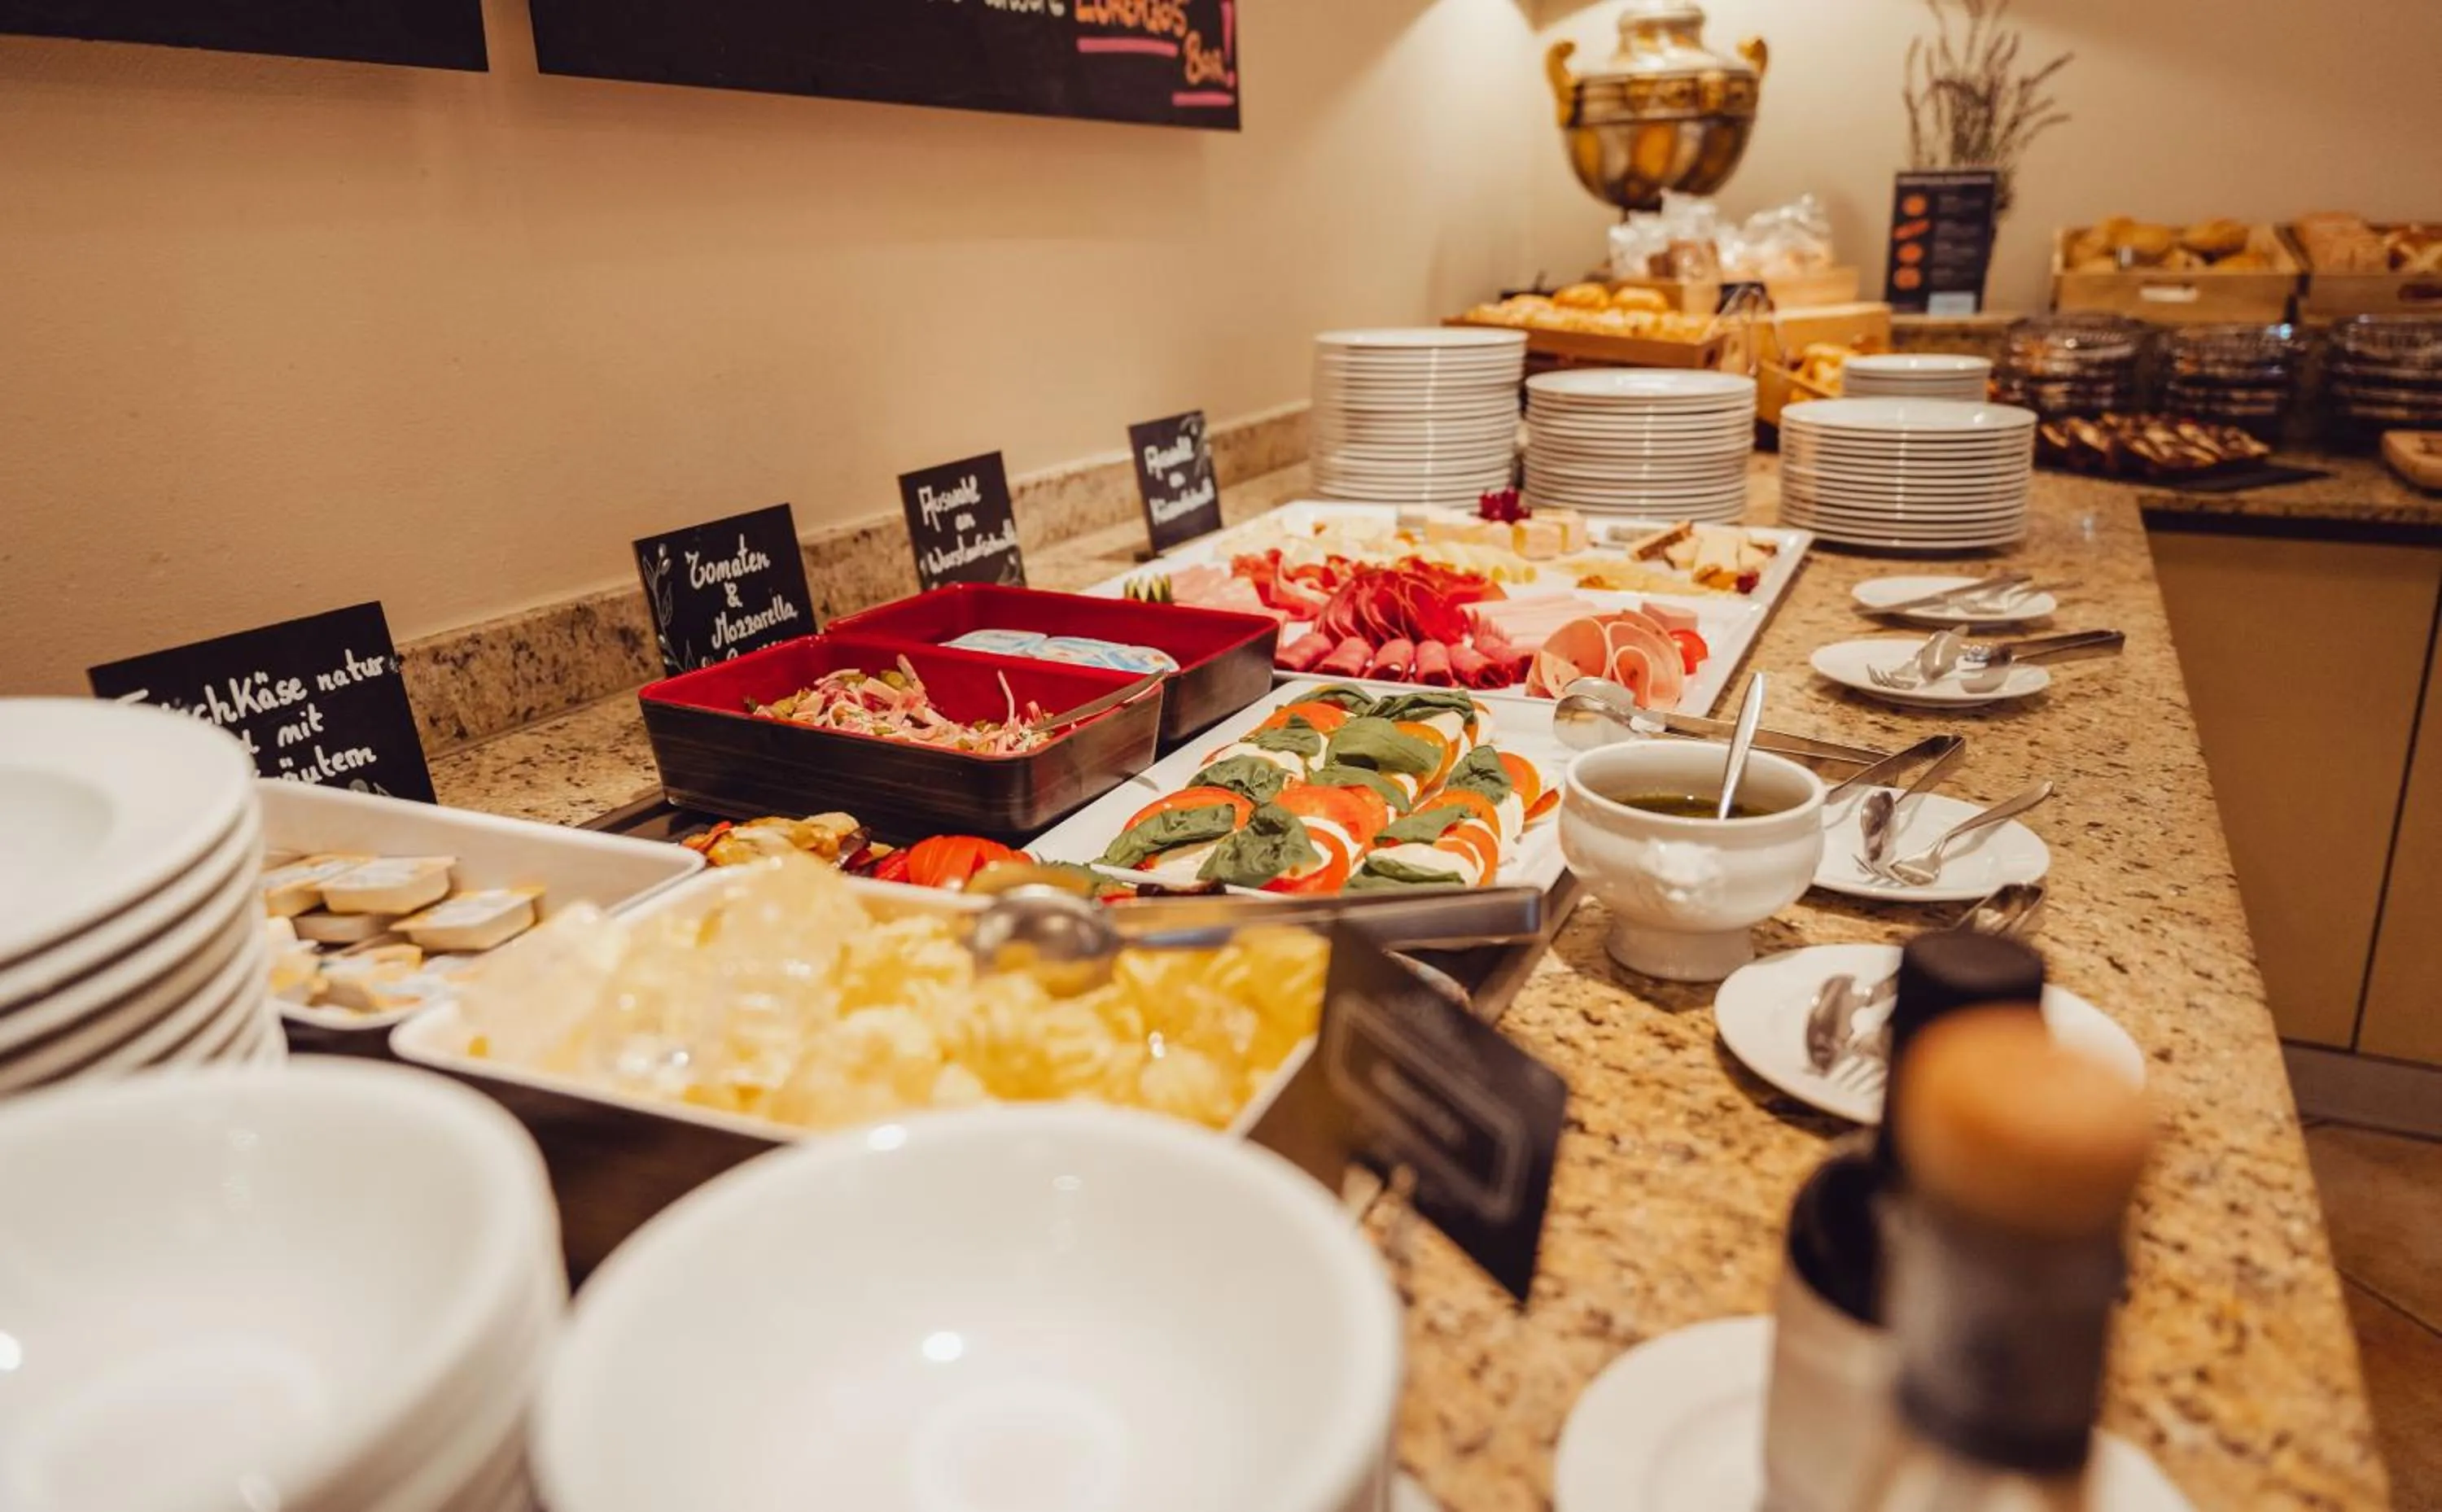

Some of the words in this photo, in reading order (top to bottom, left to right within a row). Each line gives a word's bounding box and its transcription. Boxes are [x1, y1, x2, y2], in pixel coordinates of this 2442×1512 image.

[685, 534, 771, 590] Tomaten
[724, 583, 743, 607] &
[711, 595, 799, 649] Mozzarella
[317, 649, 385, 692] natur
[278, 702, 324, 747] mit
